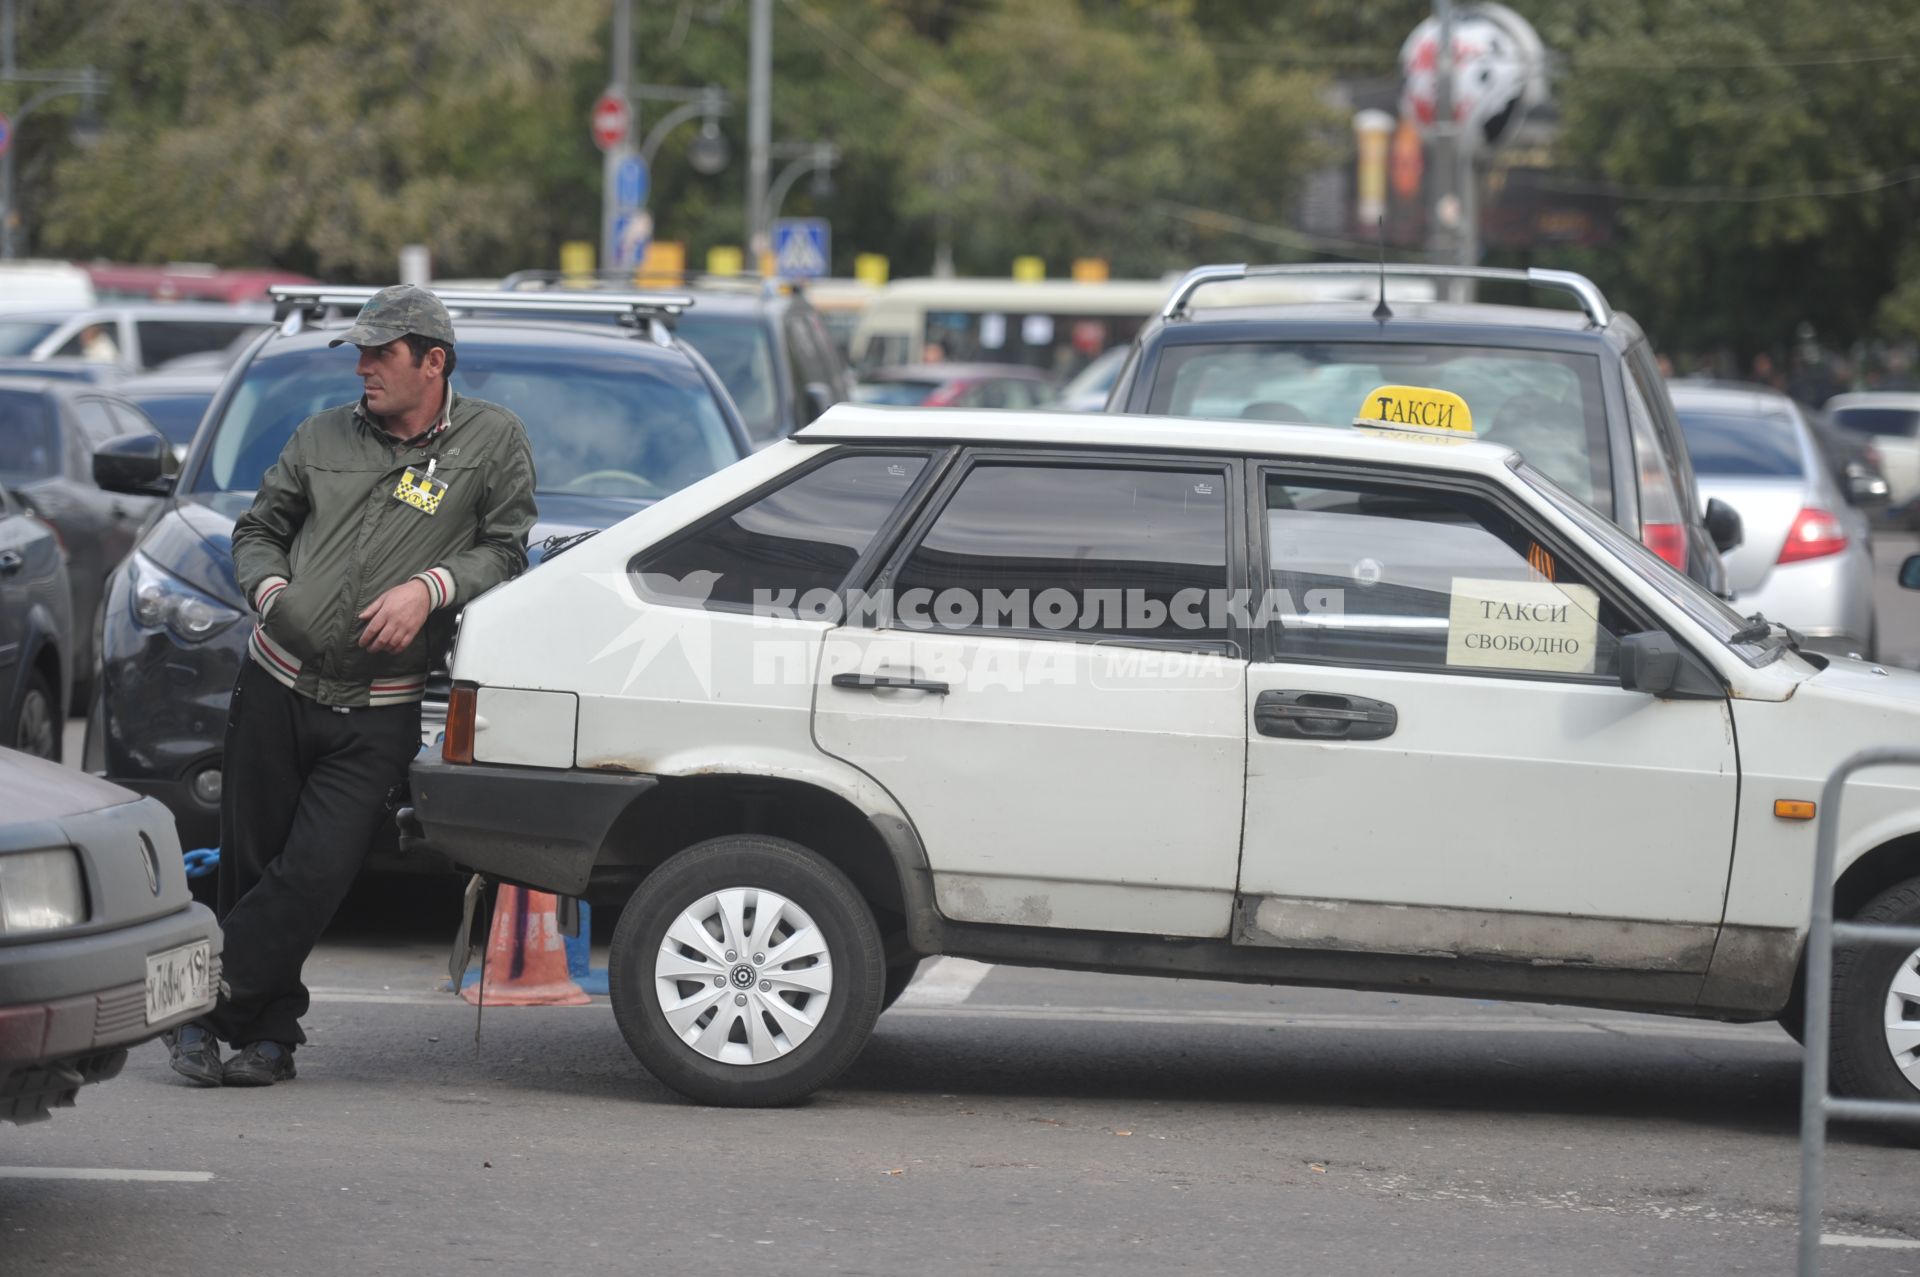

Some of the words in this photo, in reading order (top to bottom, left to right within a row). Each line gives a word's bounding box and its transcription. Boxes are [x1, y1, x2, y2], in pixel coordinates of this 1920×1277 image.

[1377, 397, 1454, 428] ТАКСИ
[1480, 600, 1569, 623] ТАКСИ
[1464, 633, 1580, 656] СВОБОДНО
